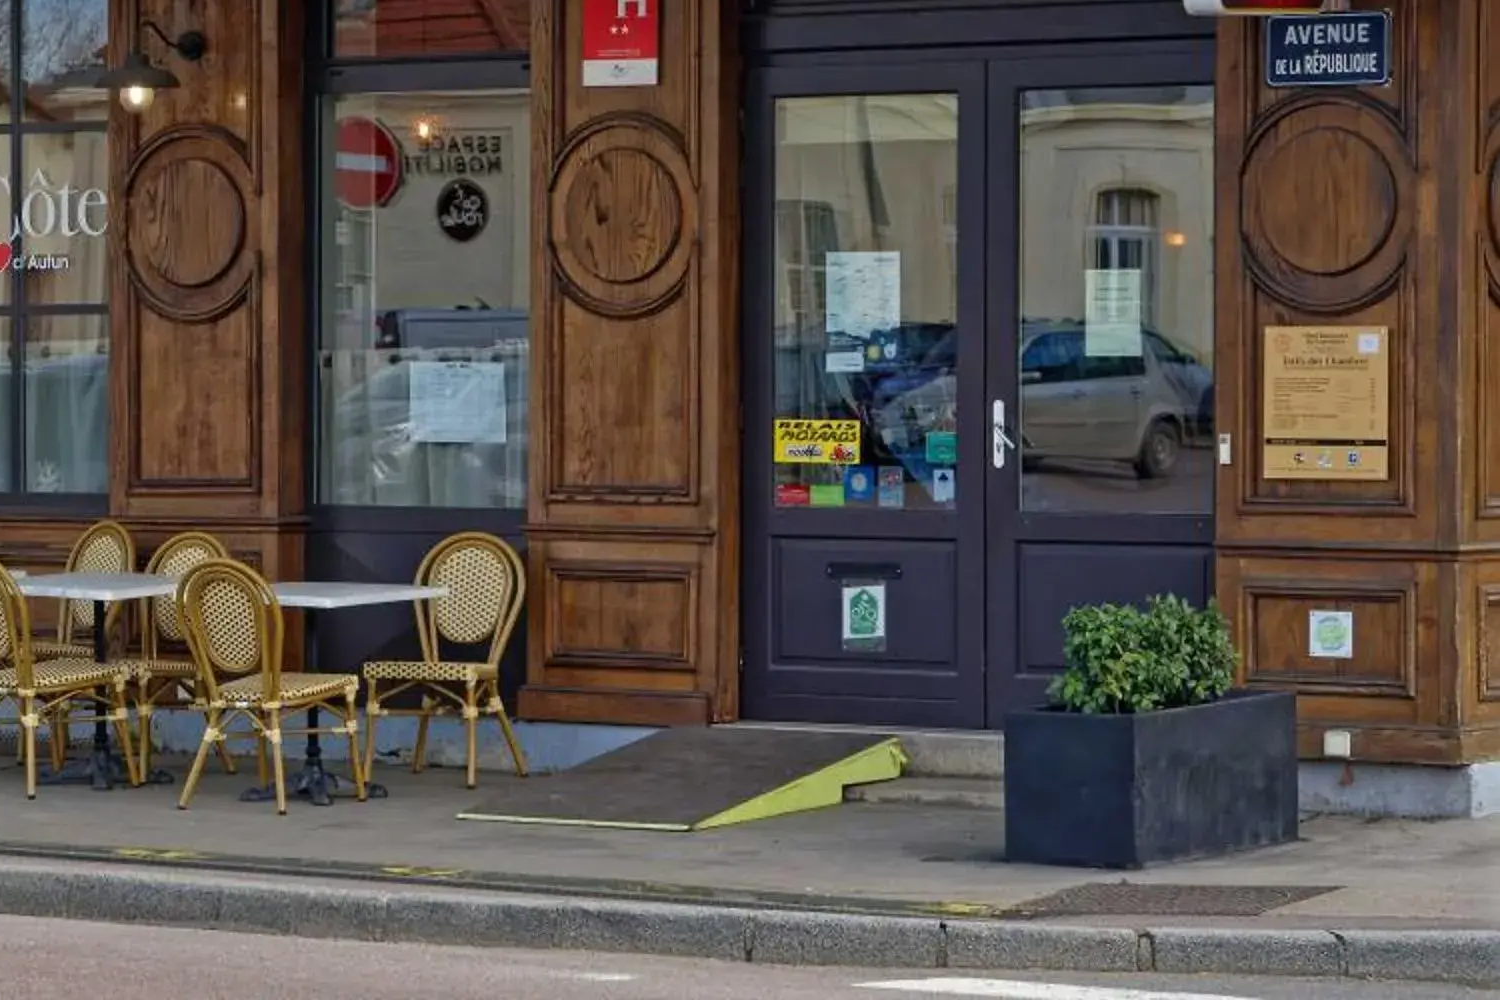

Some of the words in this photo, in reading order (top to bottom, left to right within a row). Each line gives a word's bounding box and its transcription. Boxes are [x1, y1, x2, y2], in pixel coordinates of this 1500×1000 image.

[1284, 23, 1371, 45] AVENUE
[1275, 59, 1287, 75] DE
[1289, 58, 1301, 75] LA
[1304, 49, 1378, 75] RÉPUBLIQUE
